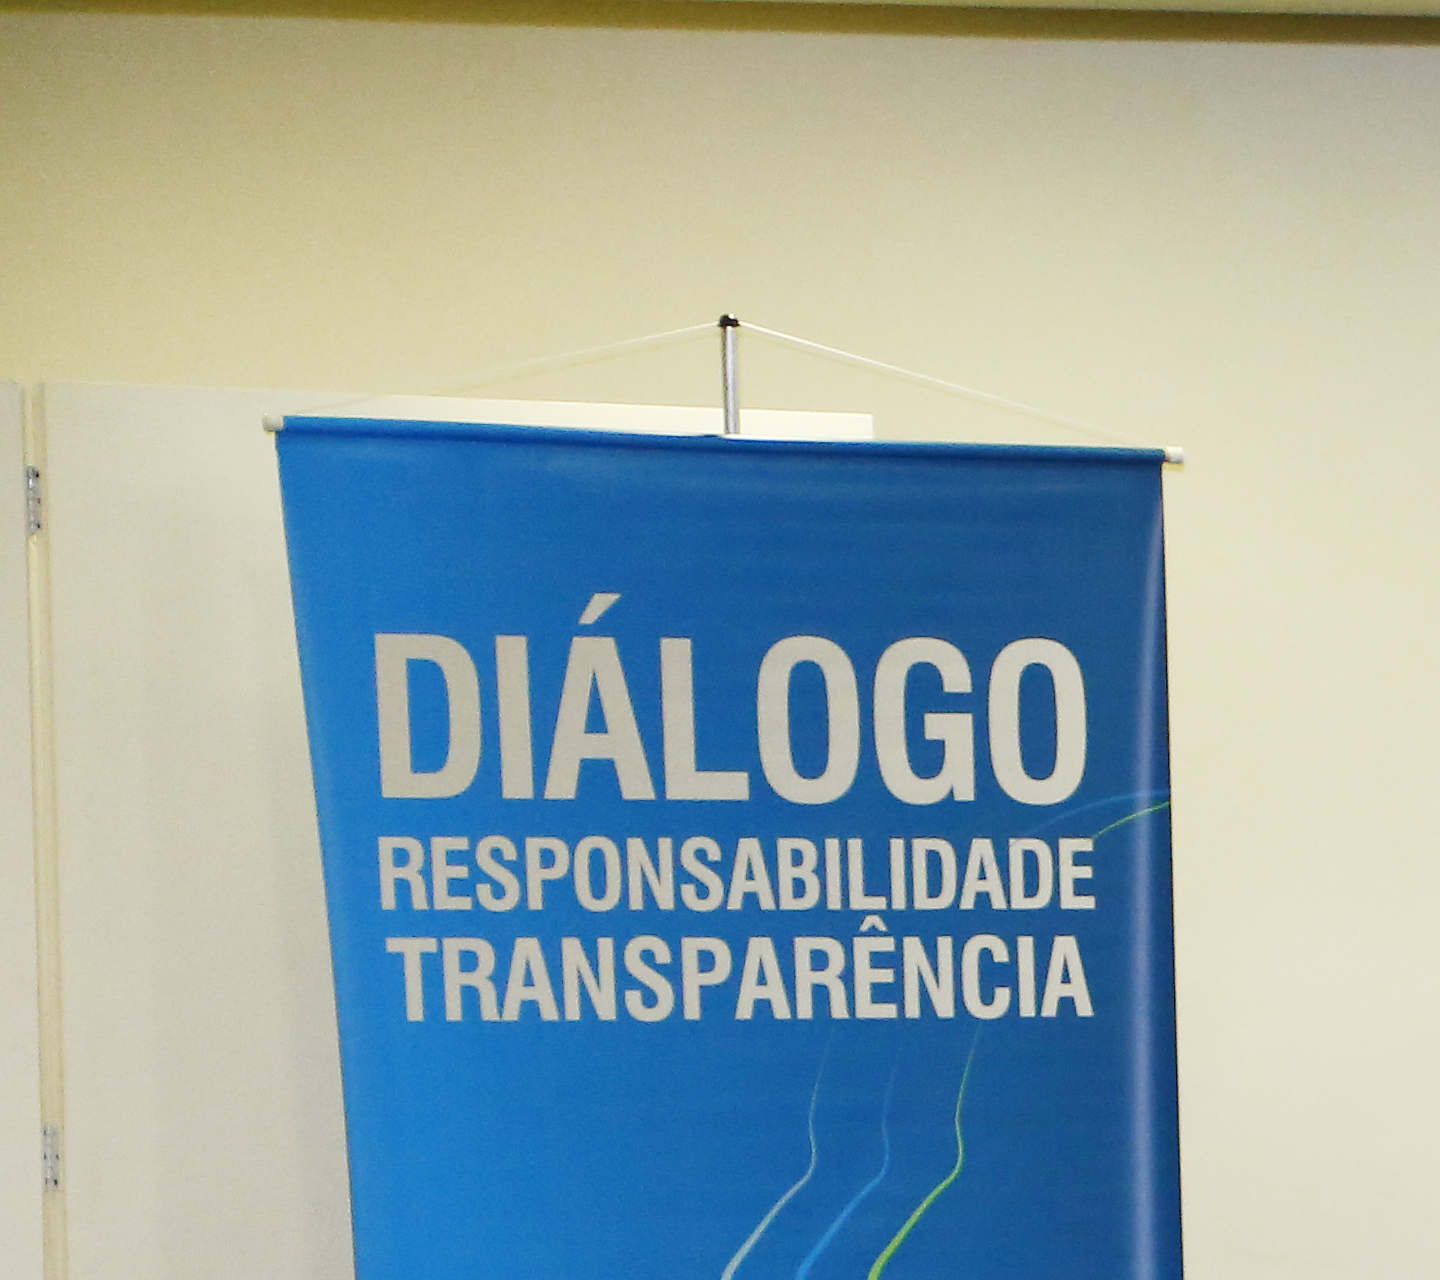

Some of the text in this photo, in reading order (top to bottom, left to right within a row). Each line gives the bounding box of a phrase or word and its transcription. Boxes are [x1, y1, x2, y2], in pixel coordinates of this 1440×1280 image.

[374, 593, 1087, 805] DIÁLOGO
[378, 834, 1096, 912] RESPONSABILIDADE
[386, 915, 1094, 1022] TRANSPARÊNCIA
